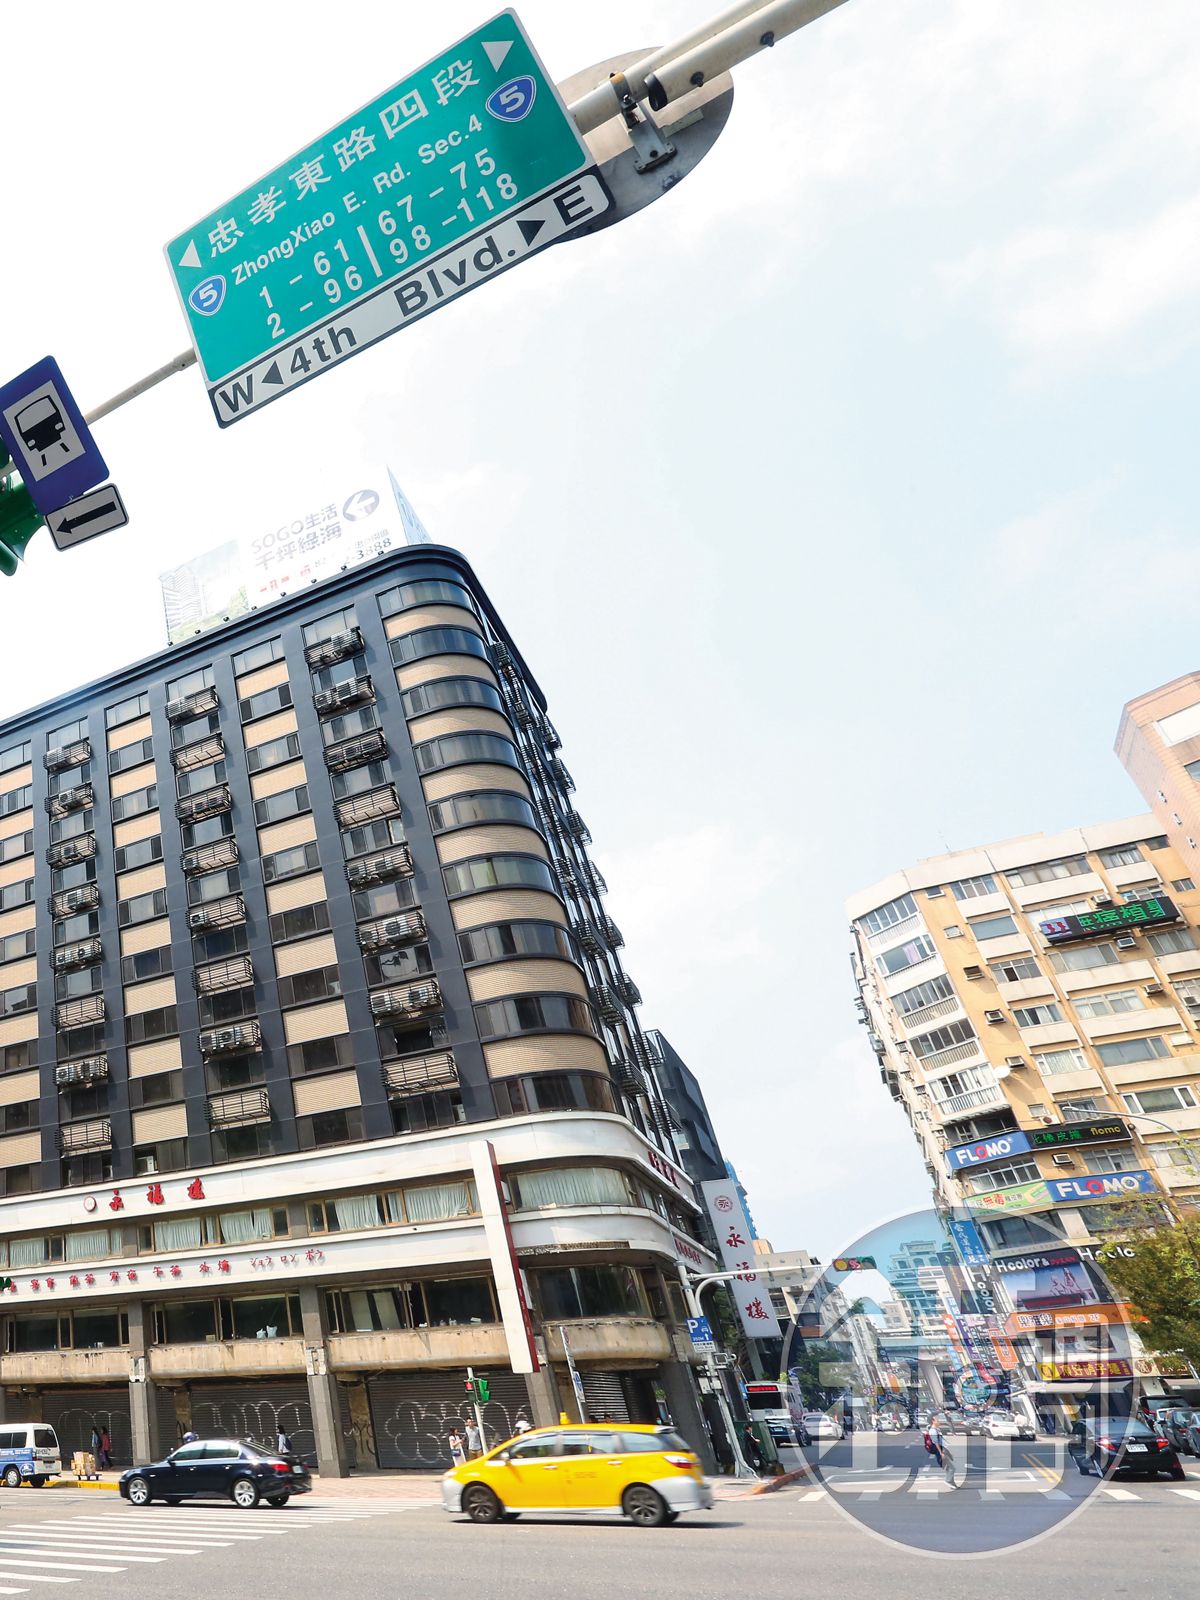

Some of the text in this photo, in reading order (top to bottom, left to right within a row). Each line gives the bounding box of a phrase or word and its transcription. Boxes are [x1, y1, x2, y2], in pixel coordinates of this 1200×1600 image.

[500, 84, 525, 113] 5
[208, 56, 481, 259] 忠孝東路四段
[230, 113, 483, 286] ZhongXiao E. Rd. Sec.4
[377, 193, 416, 237] 67
[449, 148, 497, 190] 75
[313, 238, 351, 277] 61
[389, 225, 432, 265] 98
[199, 283, 220, 310] 5
[218, 184, 596, 414] W 4th Blvd. E
[323, 265, 364, 305] 96
[955, 1139, 1011, 1165] FLOMO
[1055, 1176, 1139, 1198] FLOMO
[687, 1319, 699, 1334] P
